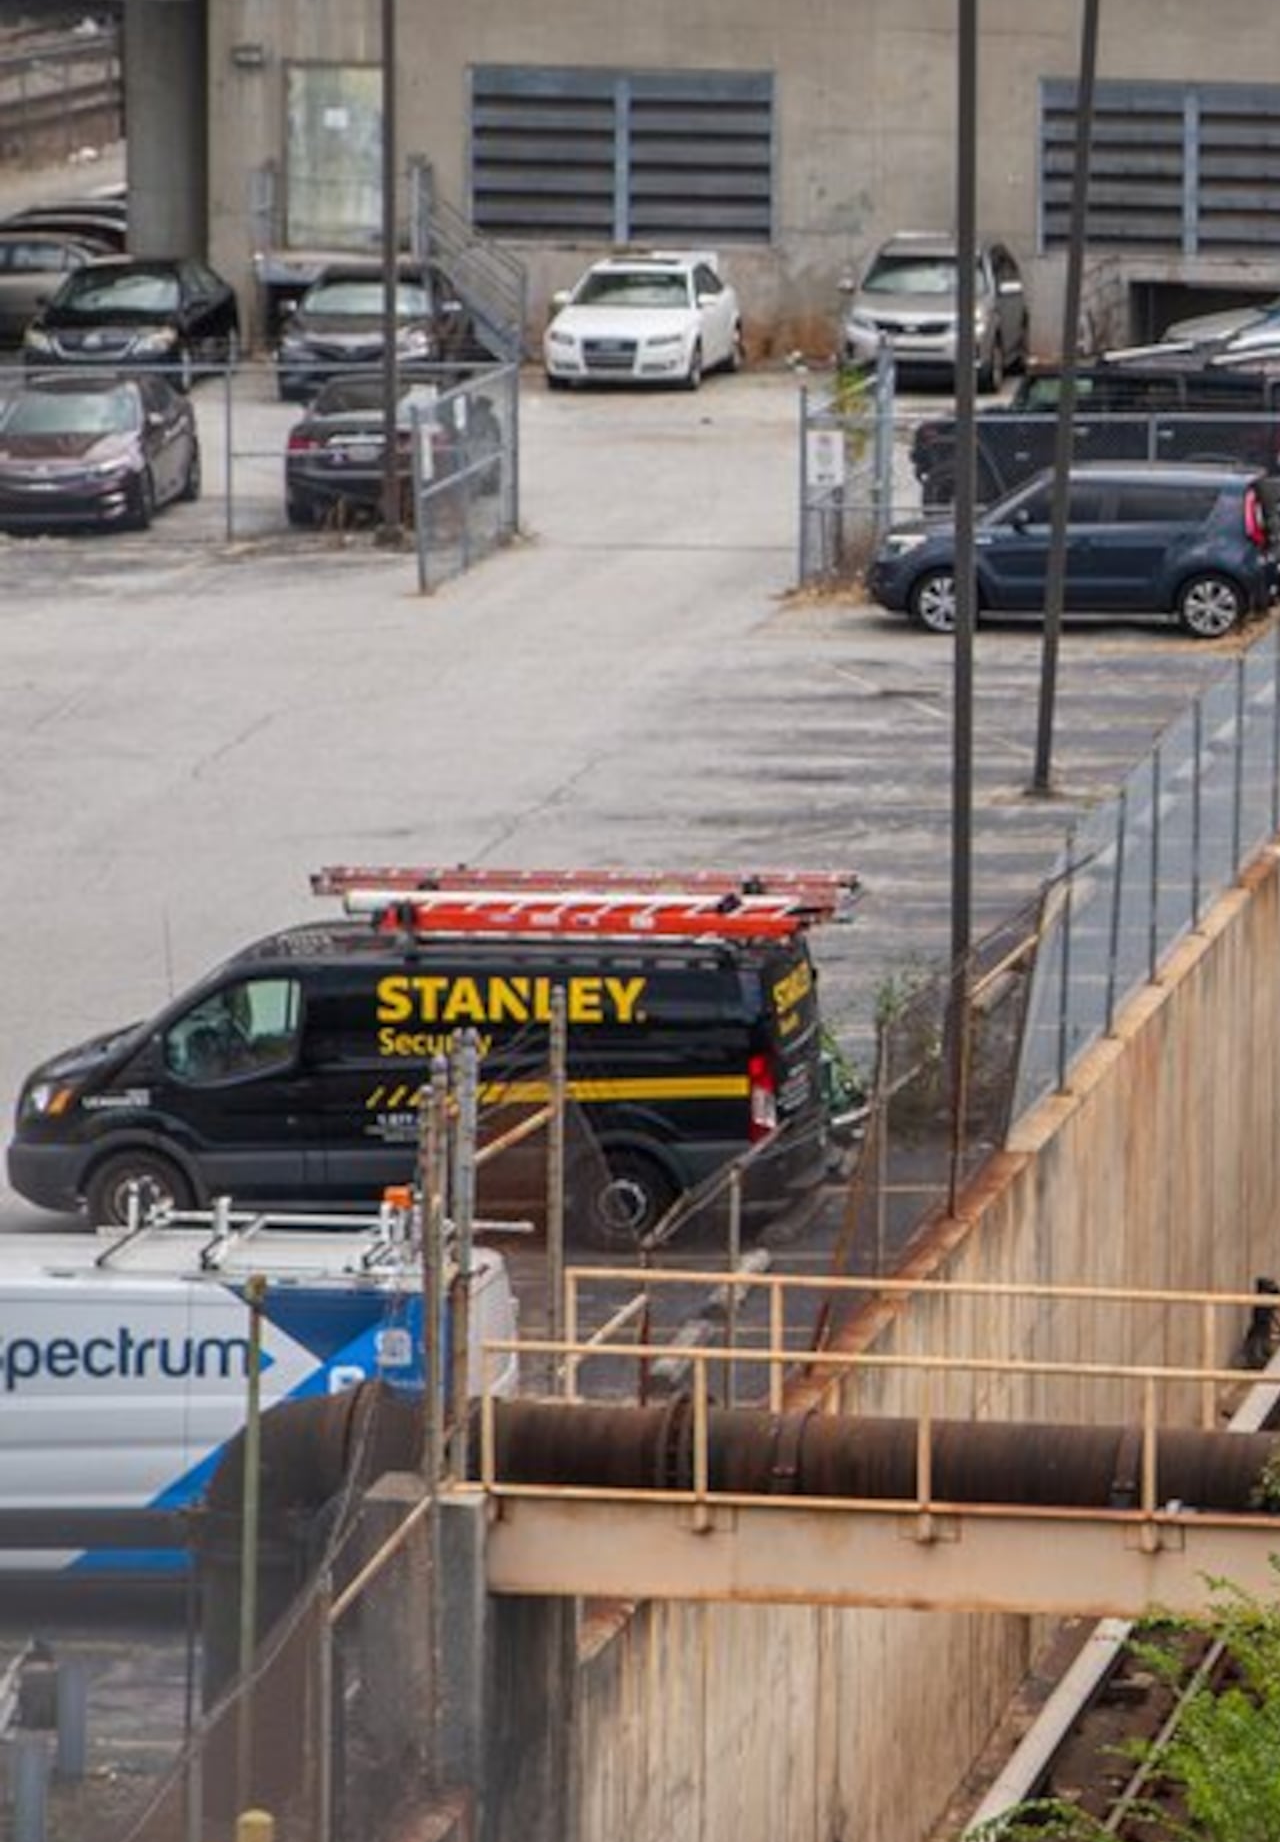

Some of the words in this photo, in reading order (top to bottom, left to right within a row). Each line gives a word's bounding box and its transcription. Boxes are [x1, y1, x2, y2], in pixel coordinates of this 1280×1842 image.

[377, 976, 646, 1023] STANLEY
[378, 1027, 492, 1058] Secury
[0, 1327, 250, 1391] pectrum
